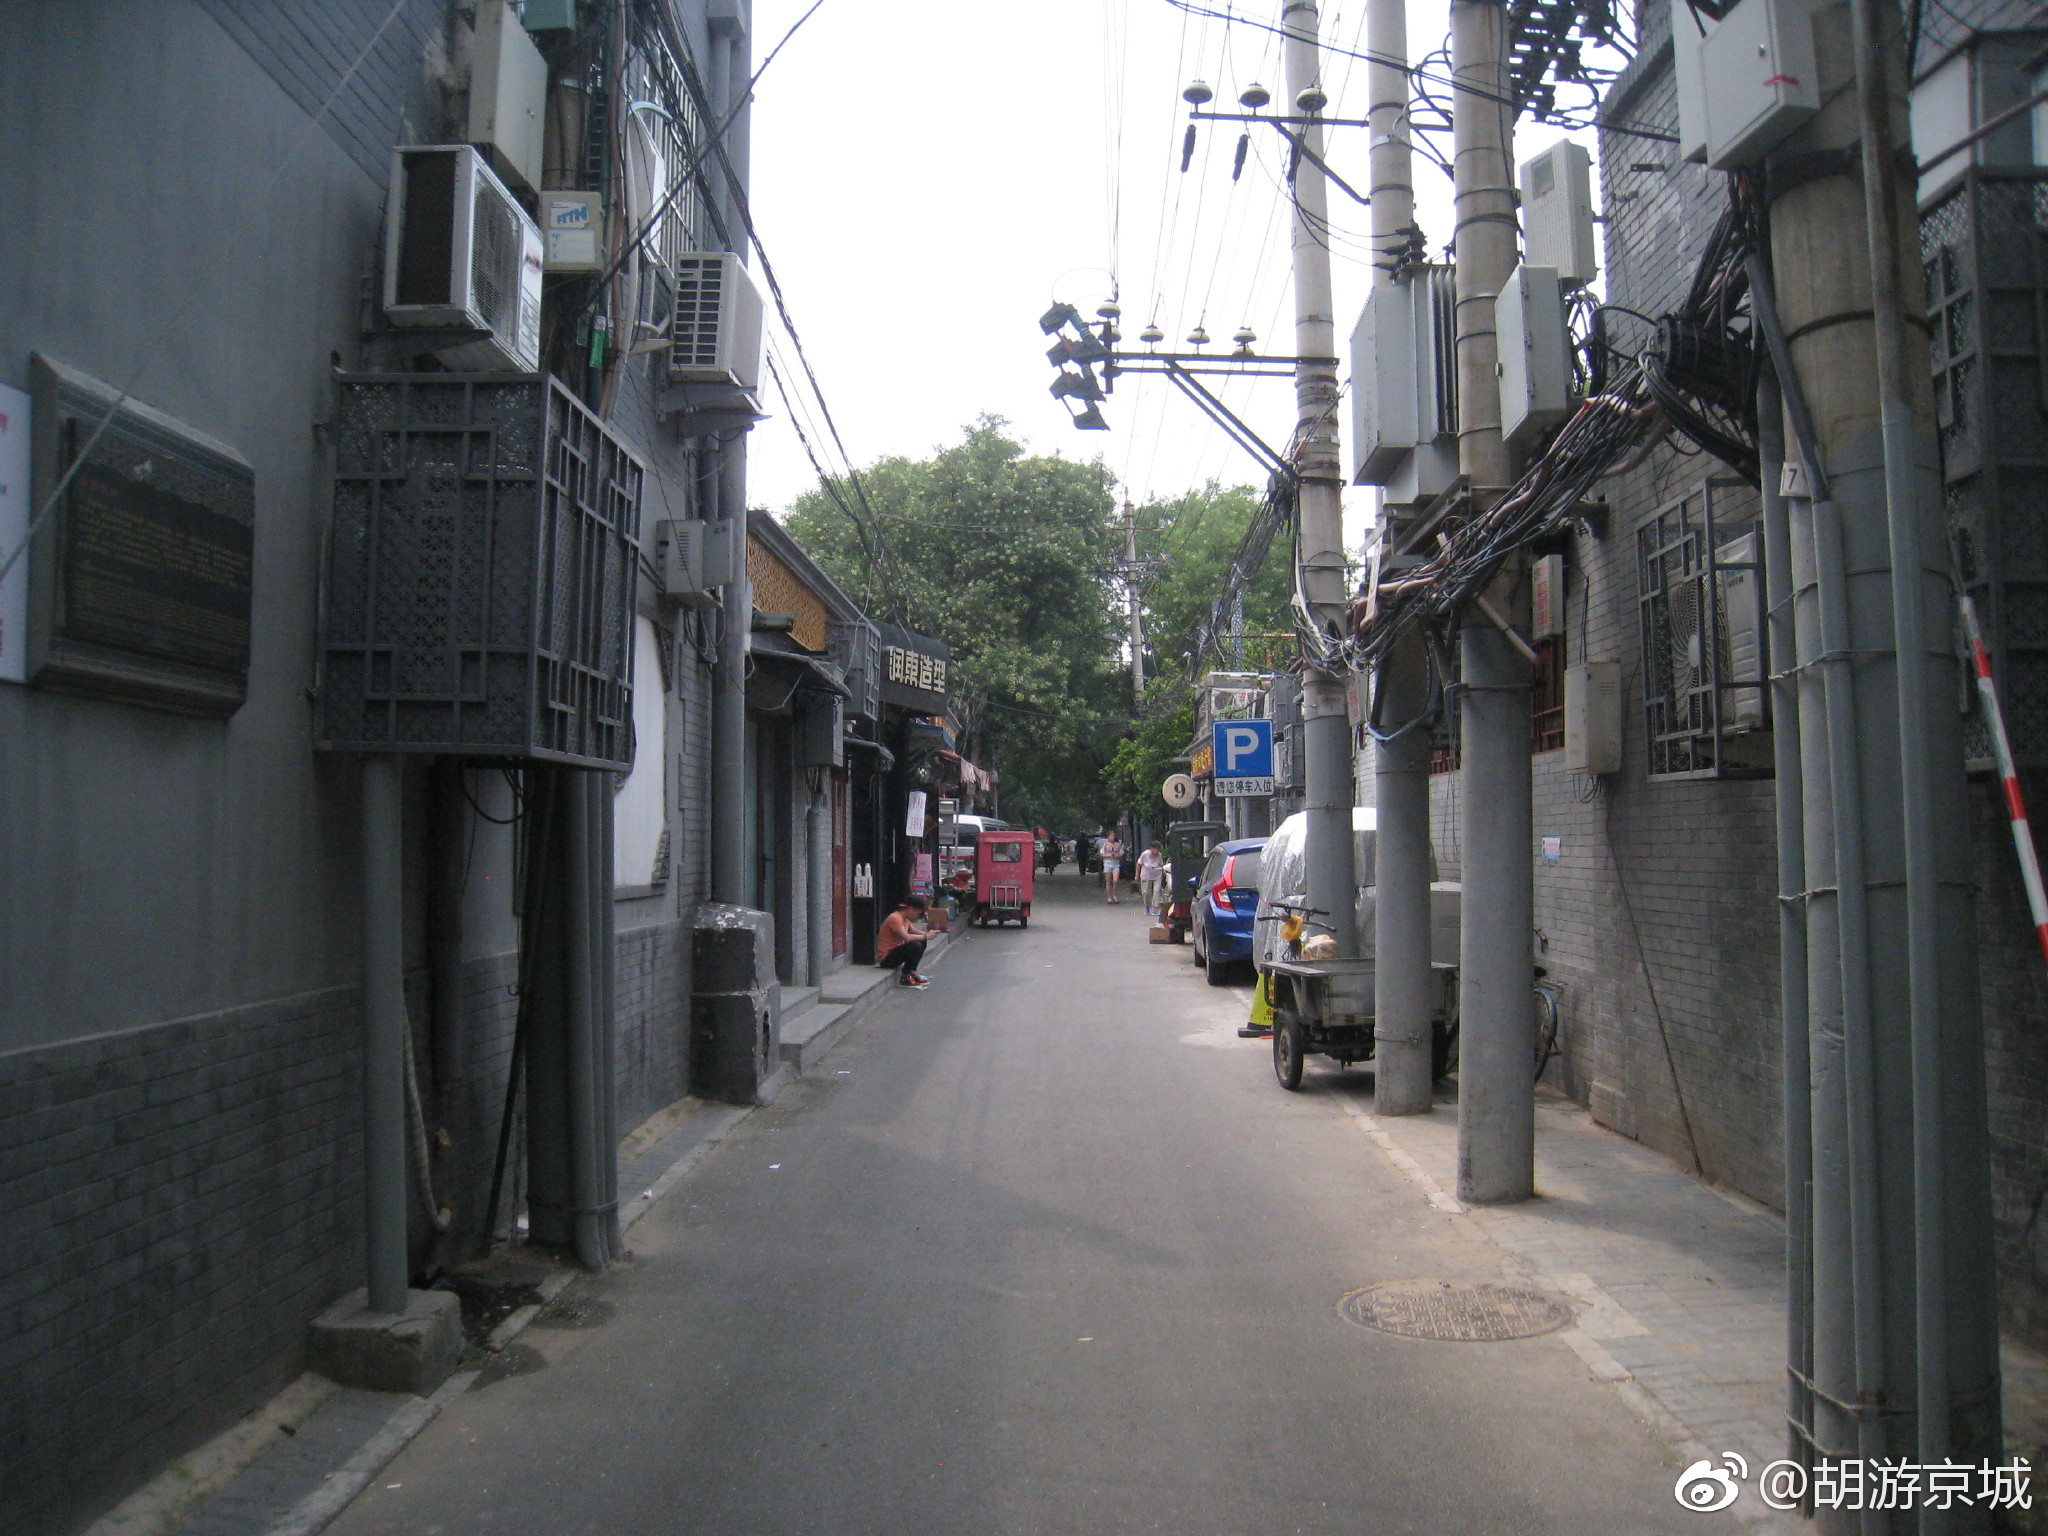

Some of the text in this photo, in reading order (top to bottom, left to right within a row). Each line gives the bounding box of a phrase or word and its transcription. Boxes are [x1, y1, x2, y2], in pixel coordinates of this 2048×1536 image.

[1789, 468, 1798, 490] 7
[1226, 728, 1259, 770] P
[1174, 783, 1186, 799] 9
[1216, 780, 1272, 793] 请您停车入位
